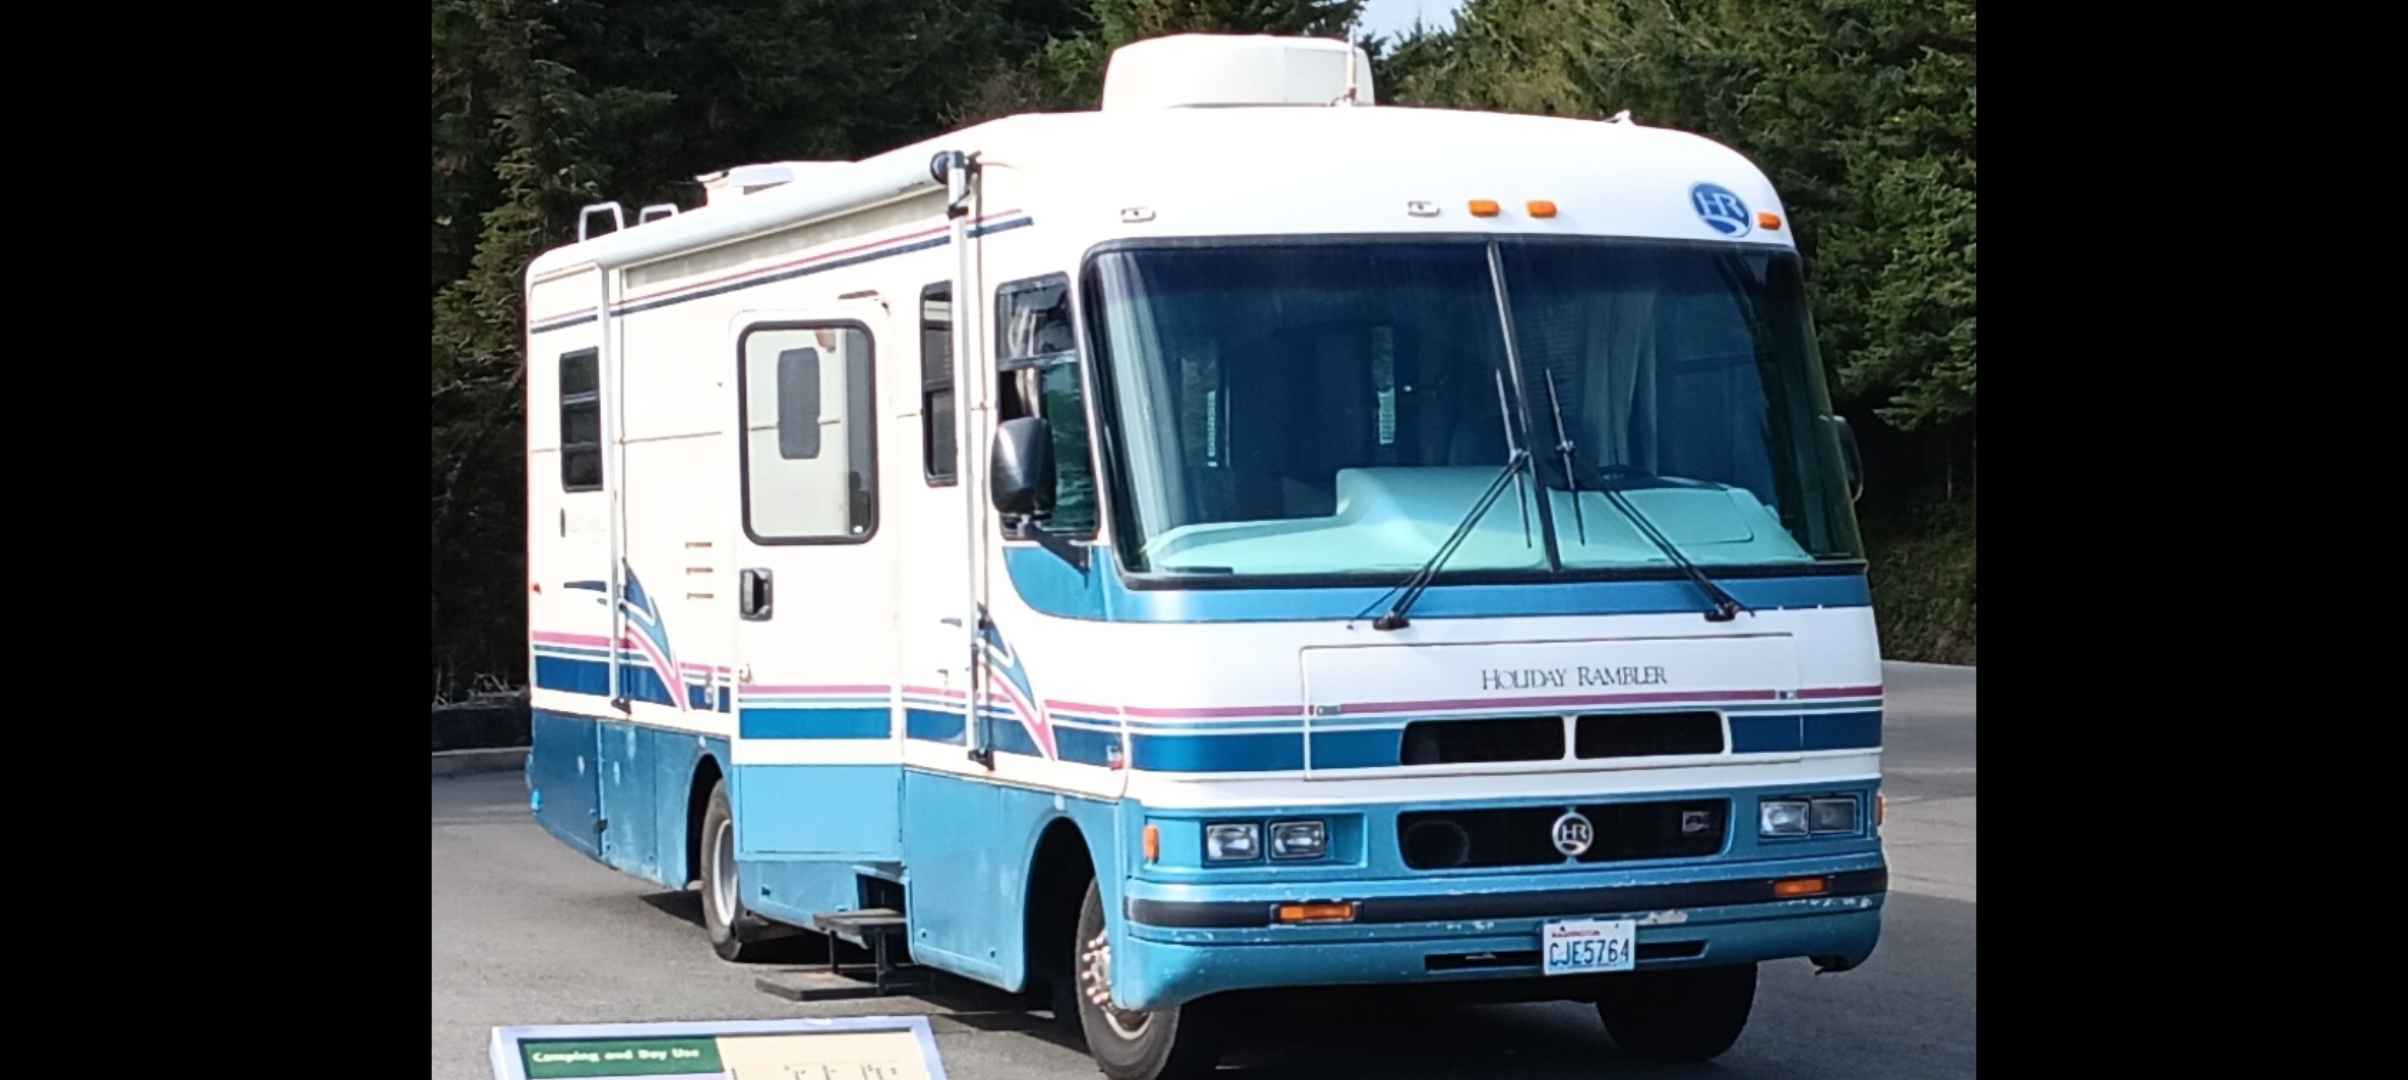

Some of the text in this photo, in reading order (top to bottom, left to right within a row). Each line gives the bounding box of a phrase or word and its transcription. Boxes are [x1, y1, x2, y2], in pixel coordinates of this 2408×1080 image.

[1482, 666, 1667, 690] HOLIDAY RAMBLER
[1550, 939, 1629, 965] CJE5764
[604, 1049, 633, 1060] and
